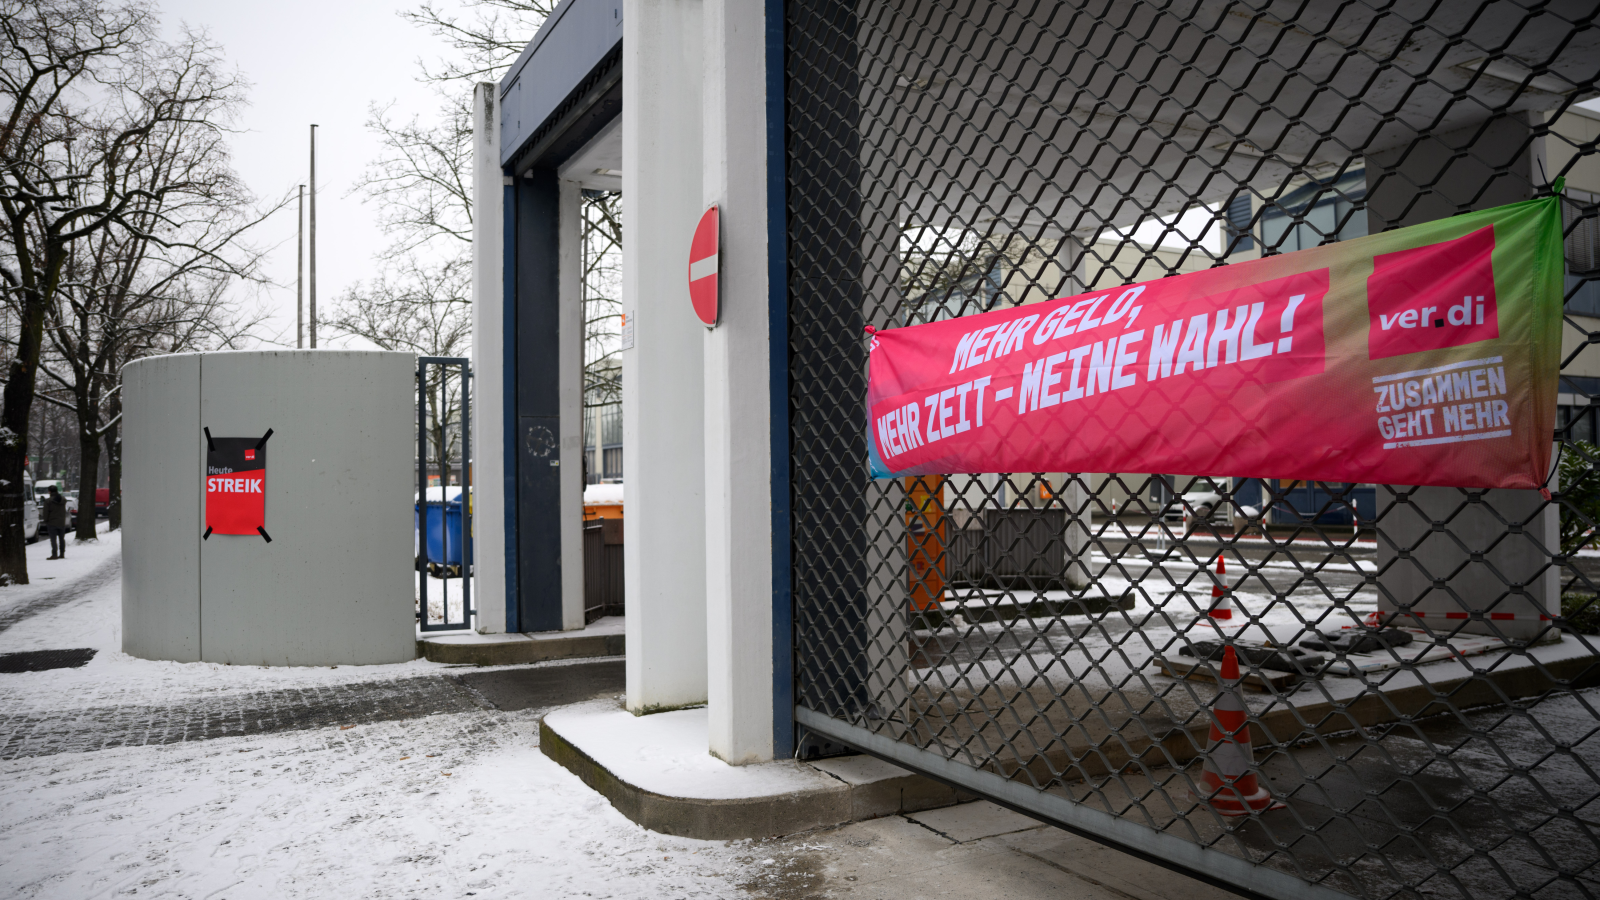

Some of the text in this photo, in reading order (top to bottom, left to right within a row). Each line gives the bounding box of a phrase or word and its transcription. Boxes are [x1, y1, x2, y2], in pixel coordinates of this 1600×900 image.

[949, 285, 1146, 374] MEHR GELD,
[1379, 295, 1485, 331] ver.di
[877, 401, 924, 460] MEHR
[924, 375, 992, 443] ZEIT
[1018, 329, 1145, 415] MEINE
[1147, 293, 1306, 382] WAHL!
[1373, 366, 1507, 413] ZUSAMMEN
[1377, 399, 1511, 440] GEHT MEHR
[208, 466, 233, 474] Heute
[208, 478, 262, 493] STREIK
